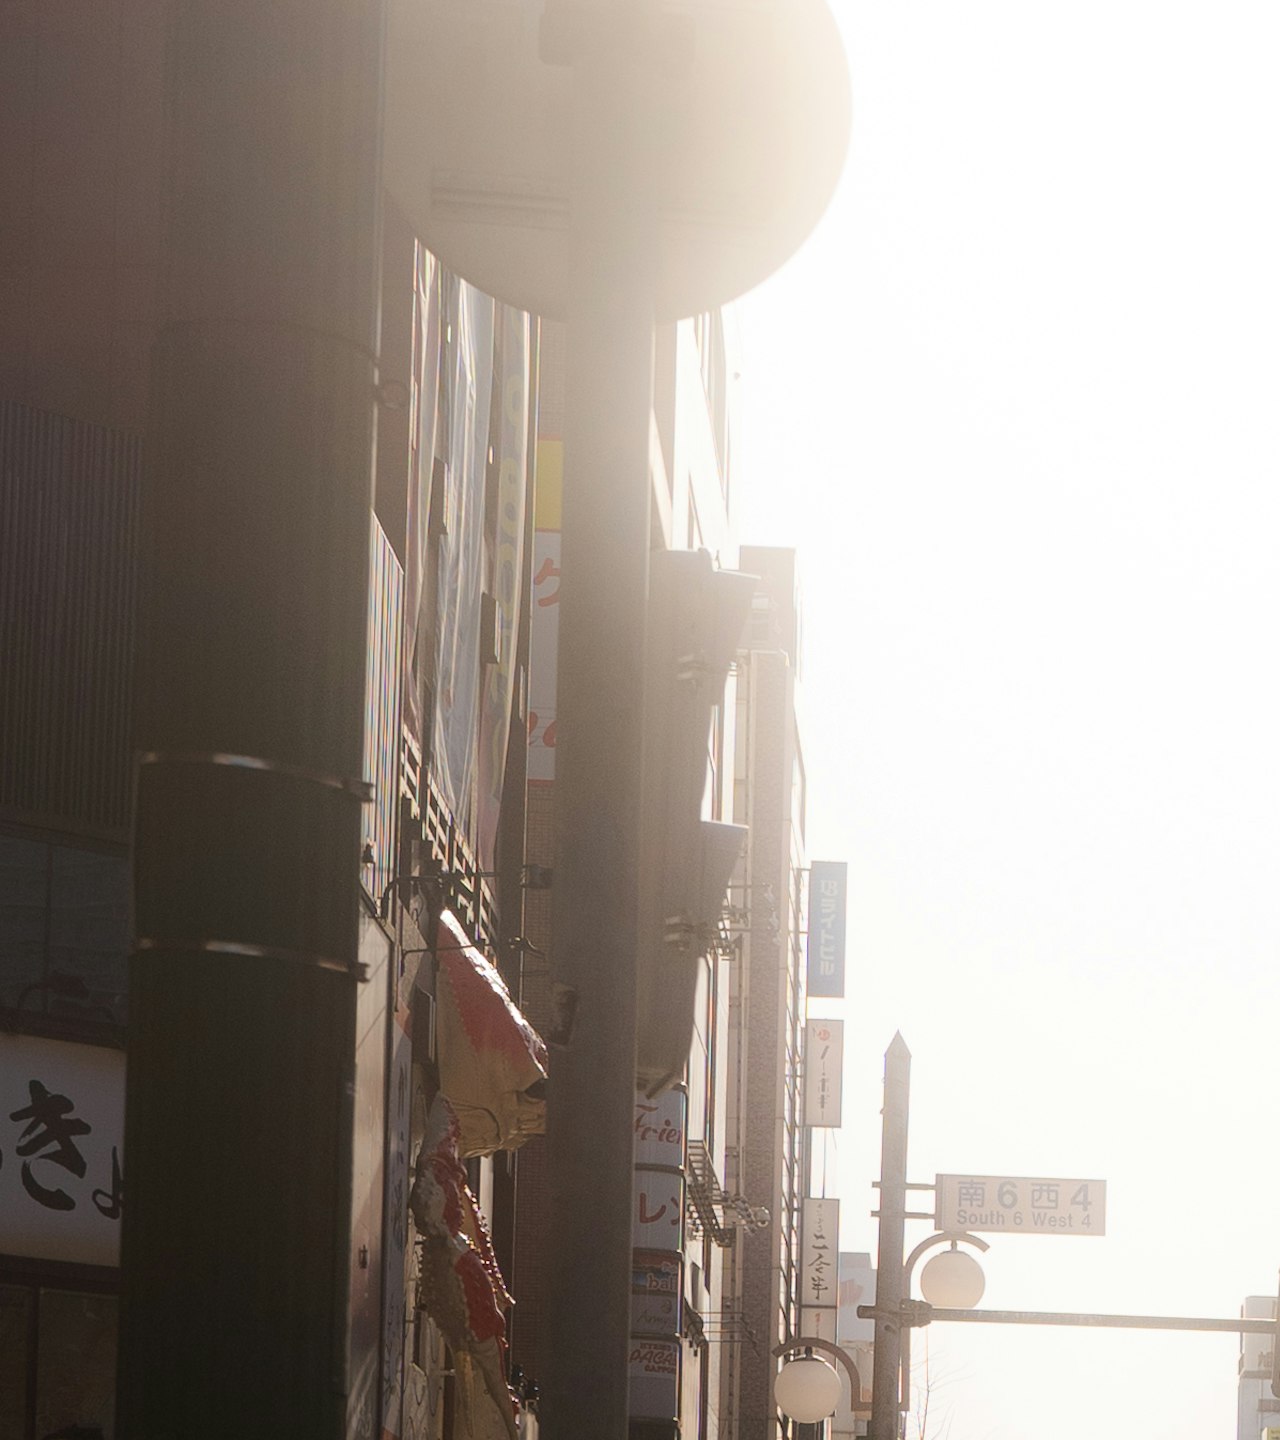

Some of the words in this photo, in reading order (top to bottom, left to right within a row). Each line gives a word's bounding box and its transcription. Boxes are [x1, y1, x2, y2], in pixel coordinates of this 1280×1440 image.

[957, 1179, 1093, 1213] 南6西4
[956, 1210, 1006, 1228] South
[1013, 1212, 1024, 1228] 6
[1031, 1212, 1074, 1230] West
[1081, 1214, 1092, 1231] 4
